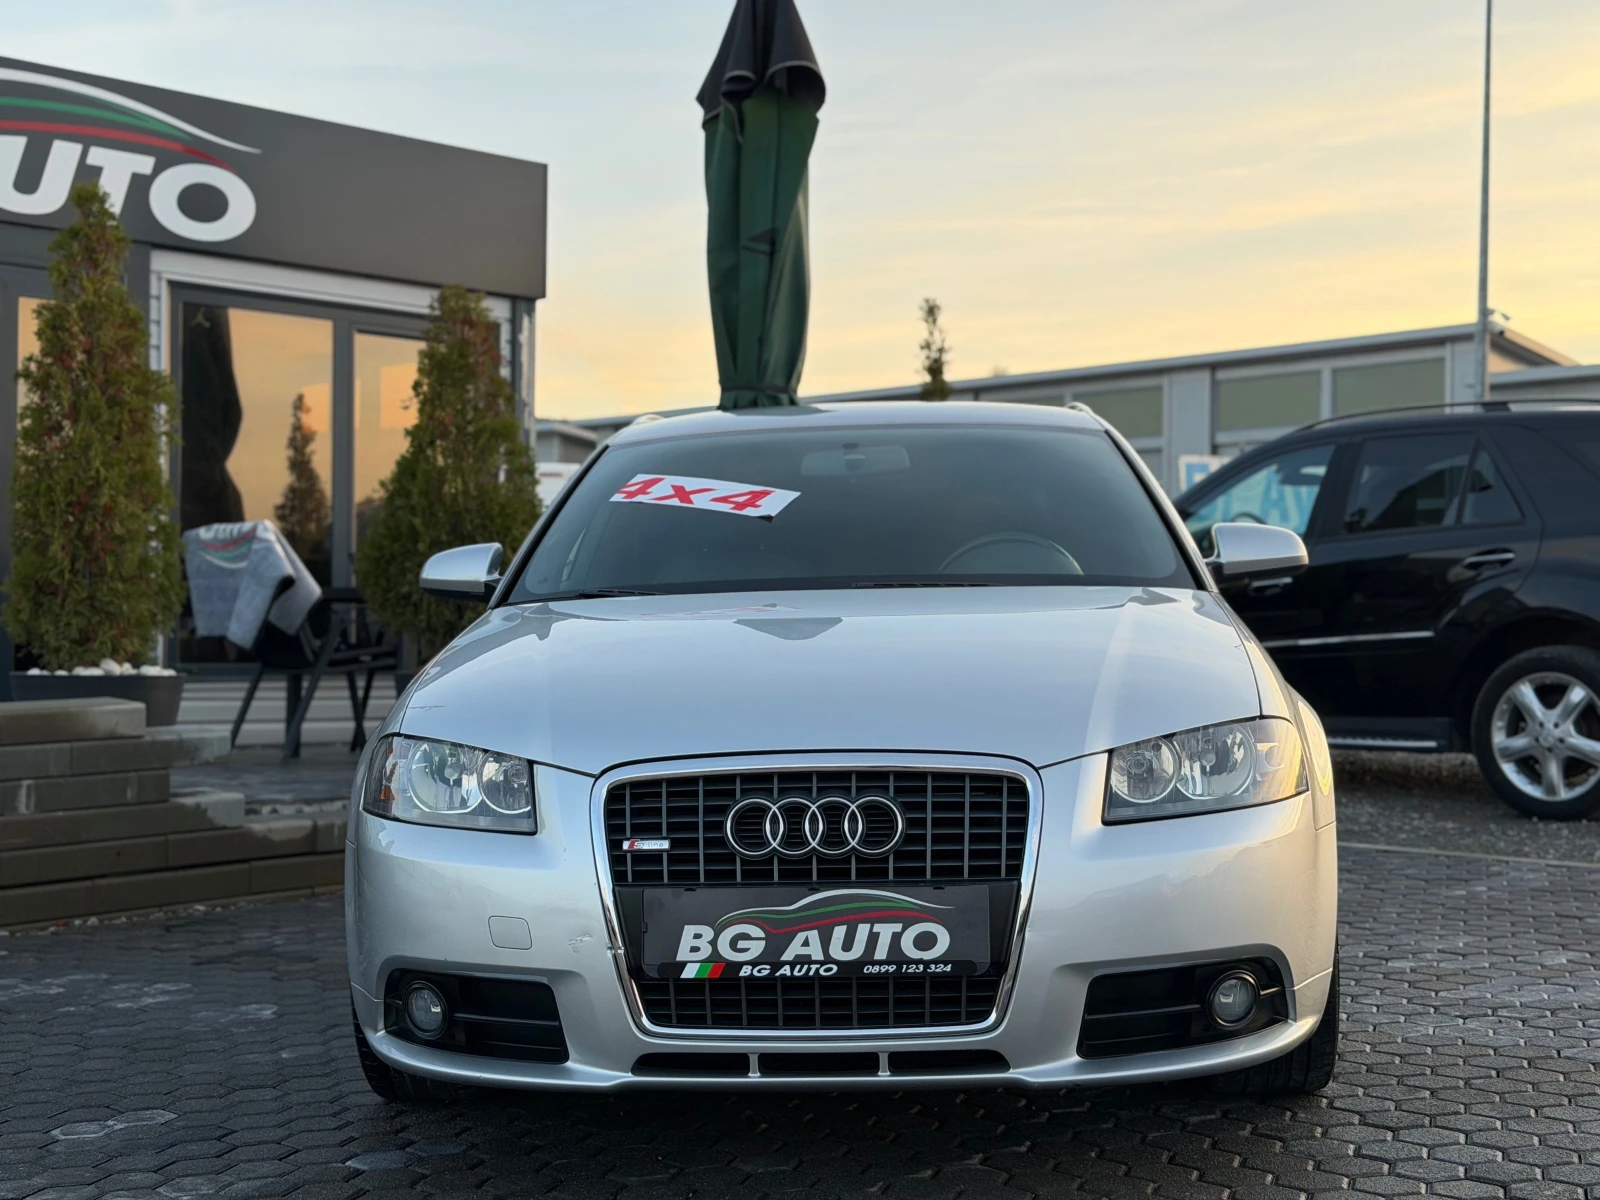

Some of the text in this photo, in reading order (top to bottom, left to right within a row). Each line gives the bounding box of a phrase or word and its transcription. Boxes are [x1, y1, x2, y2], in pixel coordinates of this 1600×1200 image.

[676, 922, 950, 961] BG AUTO
[738, 963, 952, 977] BG AUTO 0899 123 324
